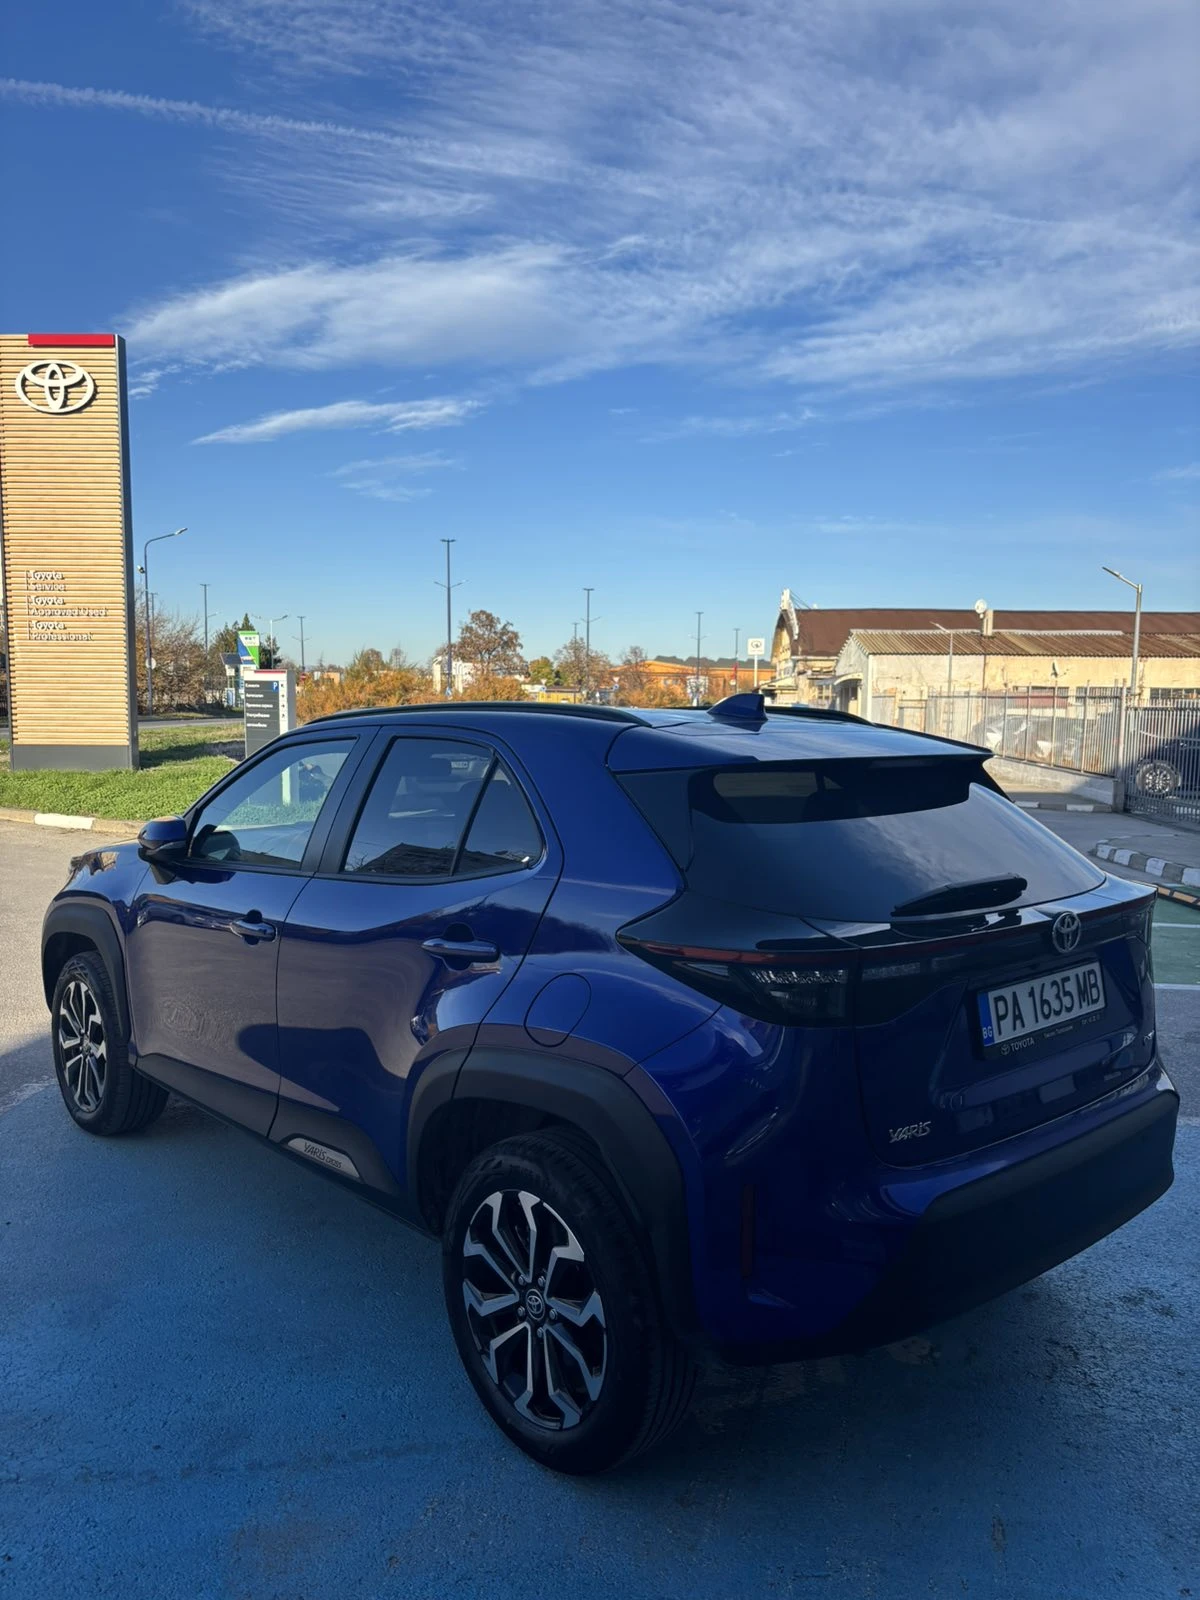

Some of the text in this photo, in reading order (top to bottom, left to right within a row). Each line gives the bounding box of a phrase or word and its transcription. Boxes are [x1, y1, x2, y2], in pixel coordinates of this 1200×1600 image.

[29, 570, 63, 581] Toyota
[31, 583, 65, 591] Service
[30, 595, 64, 606] Toyota
[31, 607, 107, 617] Approved Used
[31, 620, 65, 631] Toyota
[32, 632, 93, 641] Professional
[993, 969, 1100, 1036] PA 1635 MB
[982, 1026, 993, 1039] BG
[1010, 1037, 1035, 1052] TOYOTA
